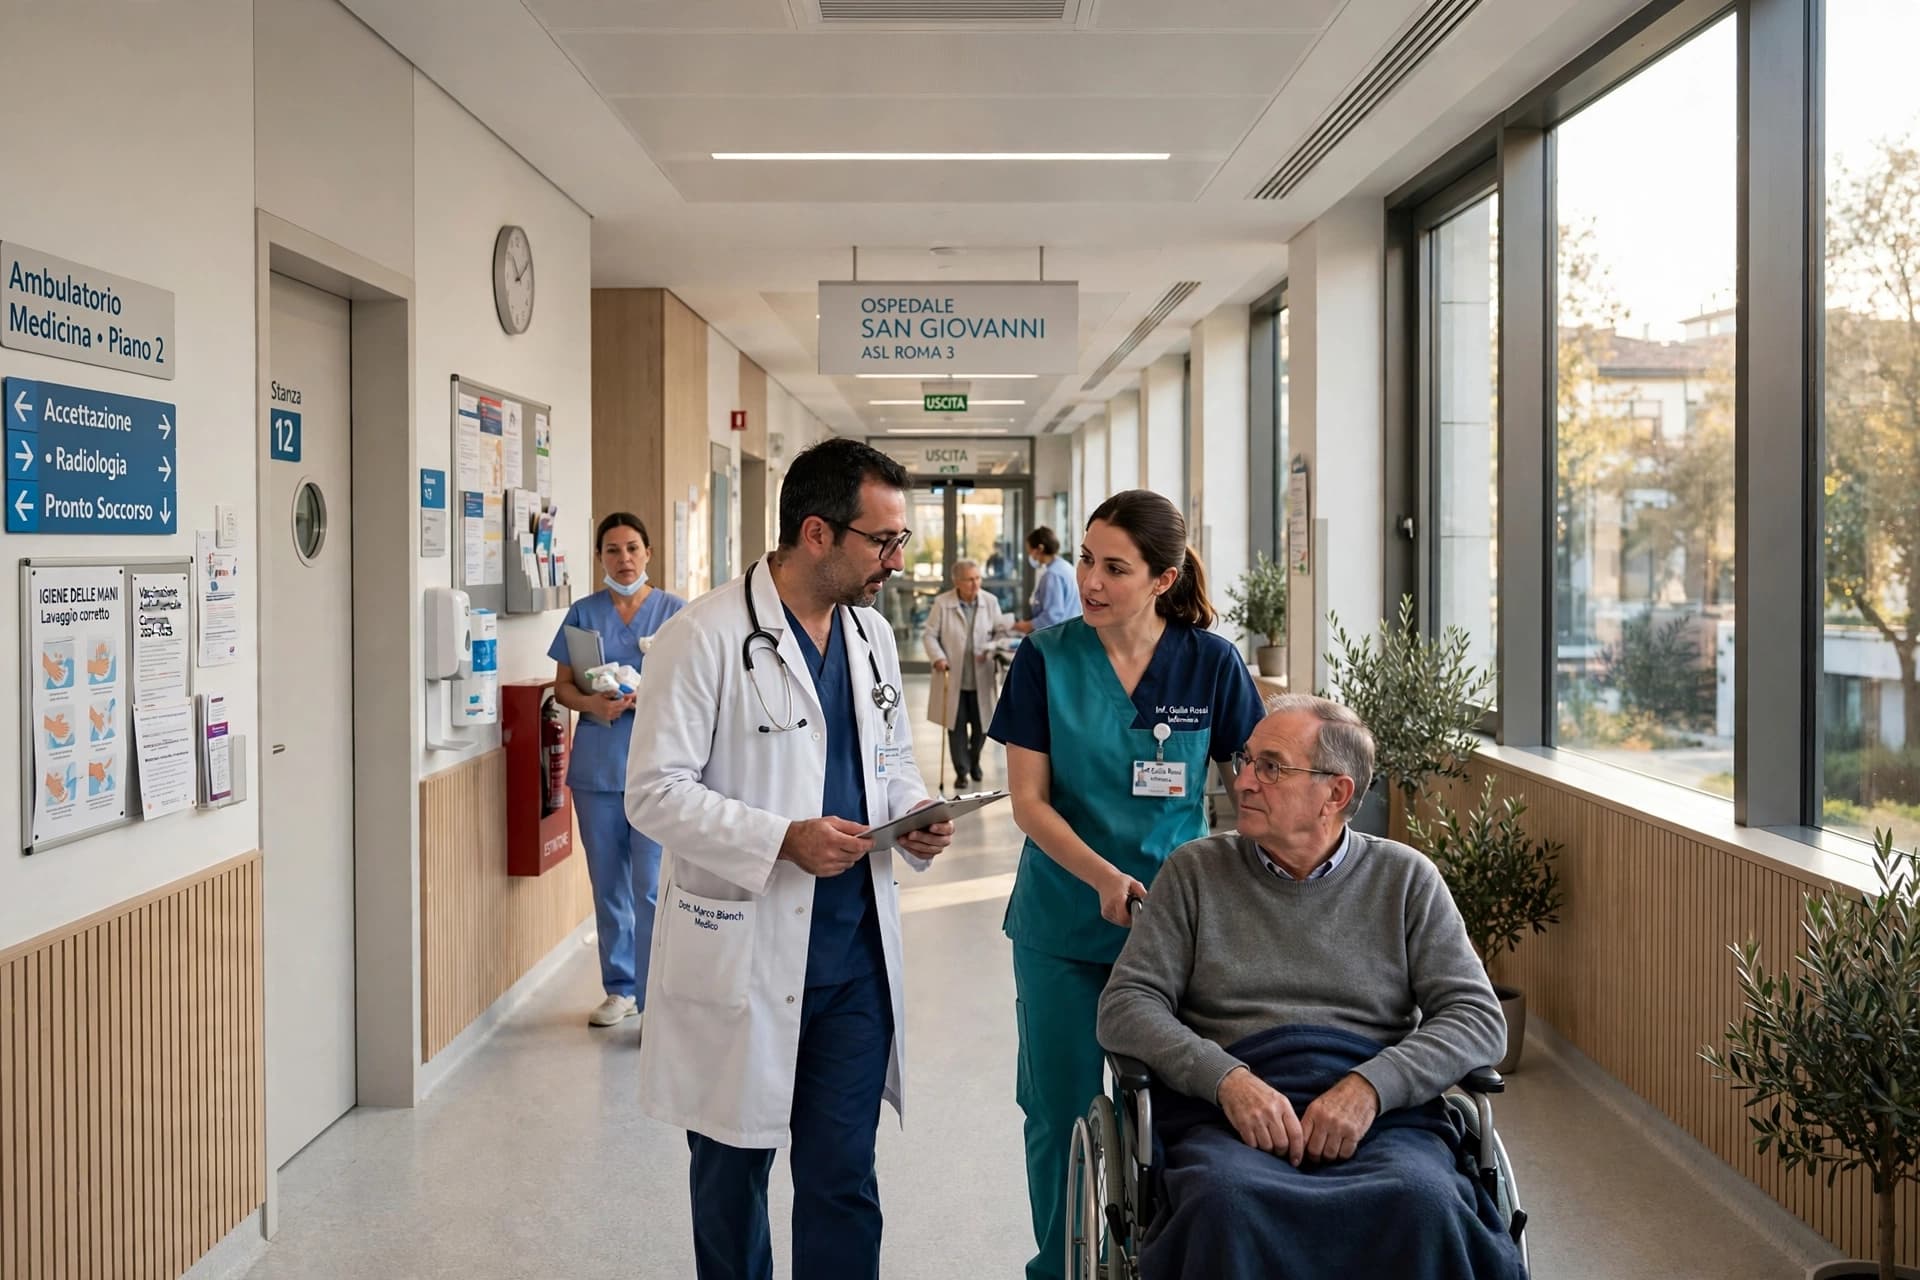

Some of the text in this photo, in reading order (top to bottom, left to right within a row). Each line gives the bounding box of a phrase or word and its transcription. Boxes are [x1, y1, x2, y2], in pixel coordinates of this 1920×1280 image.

[9, 260, 122, 316] Ambulatorio
[861, 297, 954, 314] OSPEDALE
[9, 302, 164, 364] Medicina Piano 2
[861, 317, 1046, 339] SAN GIOVANNI
[861, 346, 955, 360] ASL ROMA 3
[271, 380, 301, 405] Stanza
[926, 397, 965, 409] USCITA
[44, 397, 132, 433] Accettazione
[275, 418, 294, 453] 12
[56, 446, 127, 481] Radiologia
[926, 449, 968, 462] USCITA
[45, 493, 153, 521] Pronto Soccorso
[39, 586, 118, 604] IGIENE DELLE MANI
[41, 607, 110, 626] Lavaggio corretto
[693, 904, 715, 919] Marco
[694, 917, 719, 931] Medico
